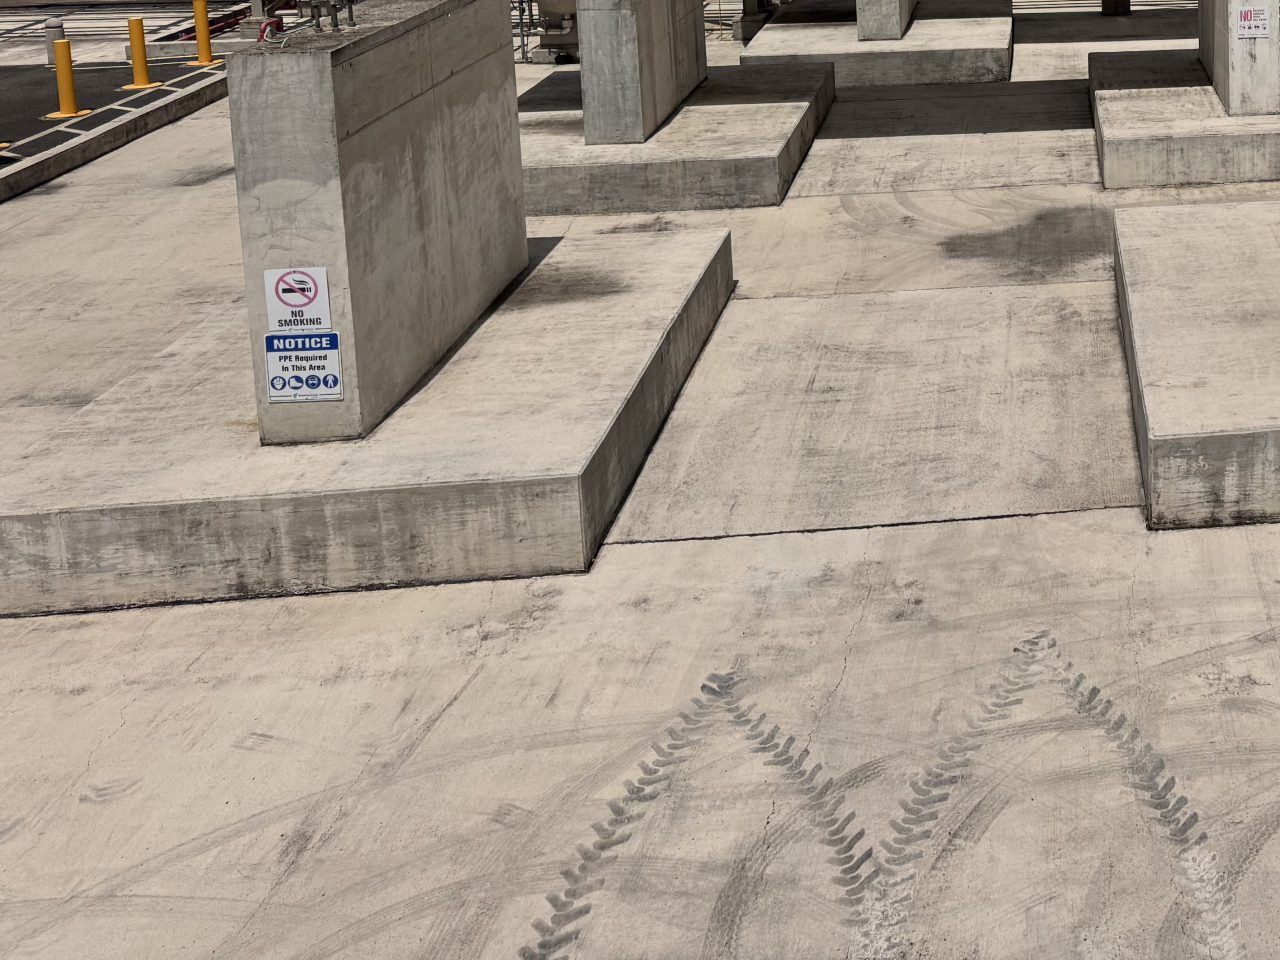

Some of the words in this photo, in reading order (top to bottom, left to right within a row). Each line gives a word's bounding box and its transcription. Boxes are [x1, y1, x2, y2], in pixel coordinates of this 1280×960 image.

[1239, 9, 1252, 22] NO
[290, 309, 304, 319] NO
[277, 317, 322, 328] SMOKING
[273, 337, 331, 350] NOTICE
[278, 355, 293, 363] PPE
[295, 354, 328, 363] Required
[291, 364, 307, 372] This
[308, 363, 326, 371] Area
